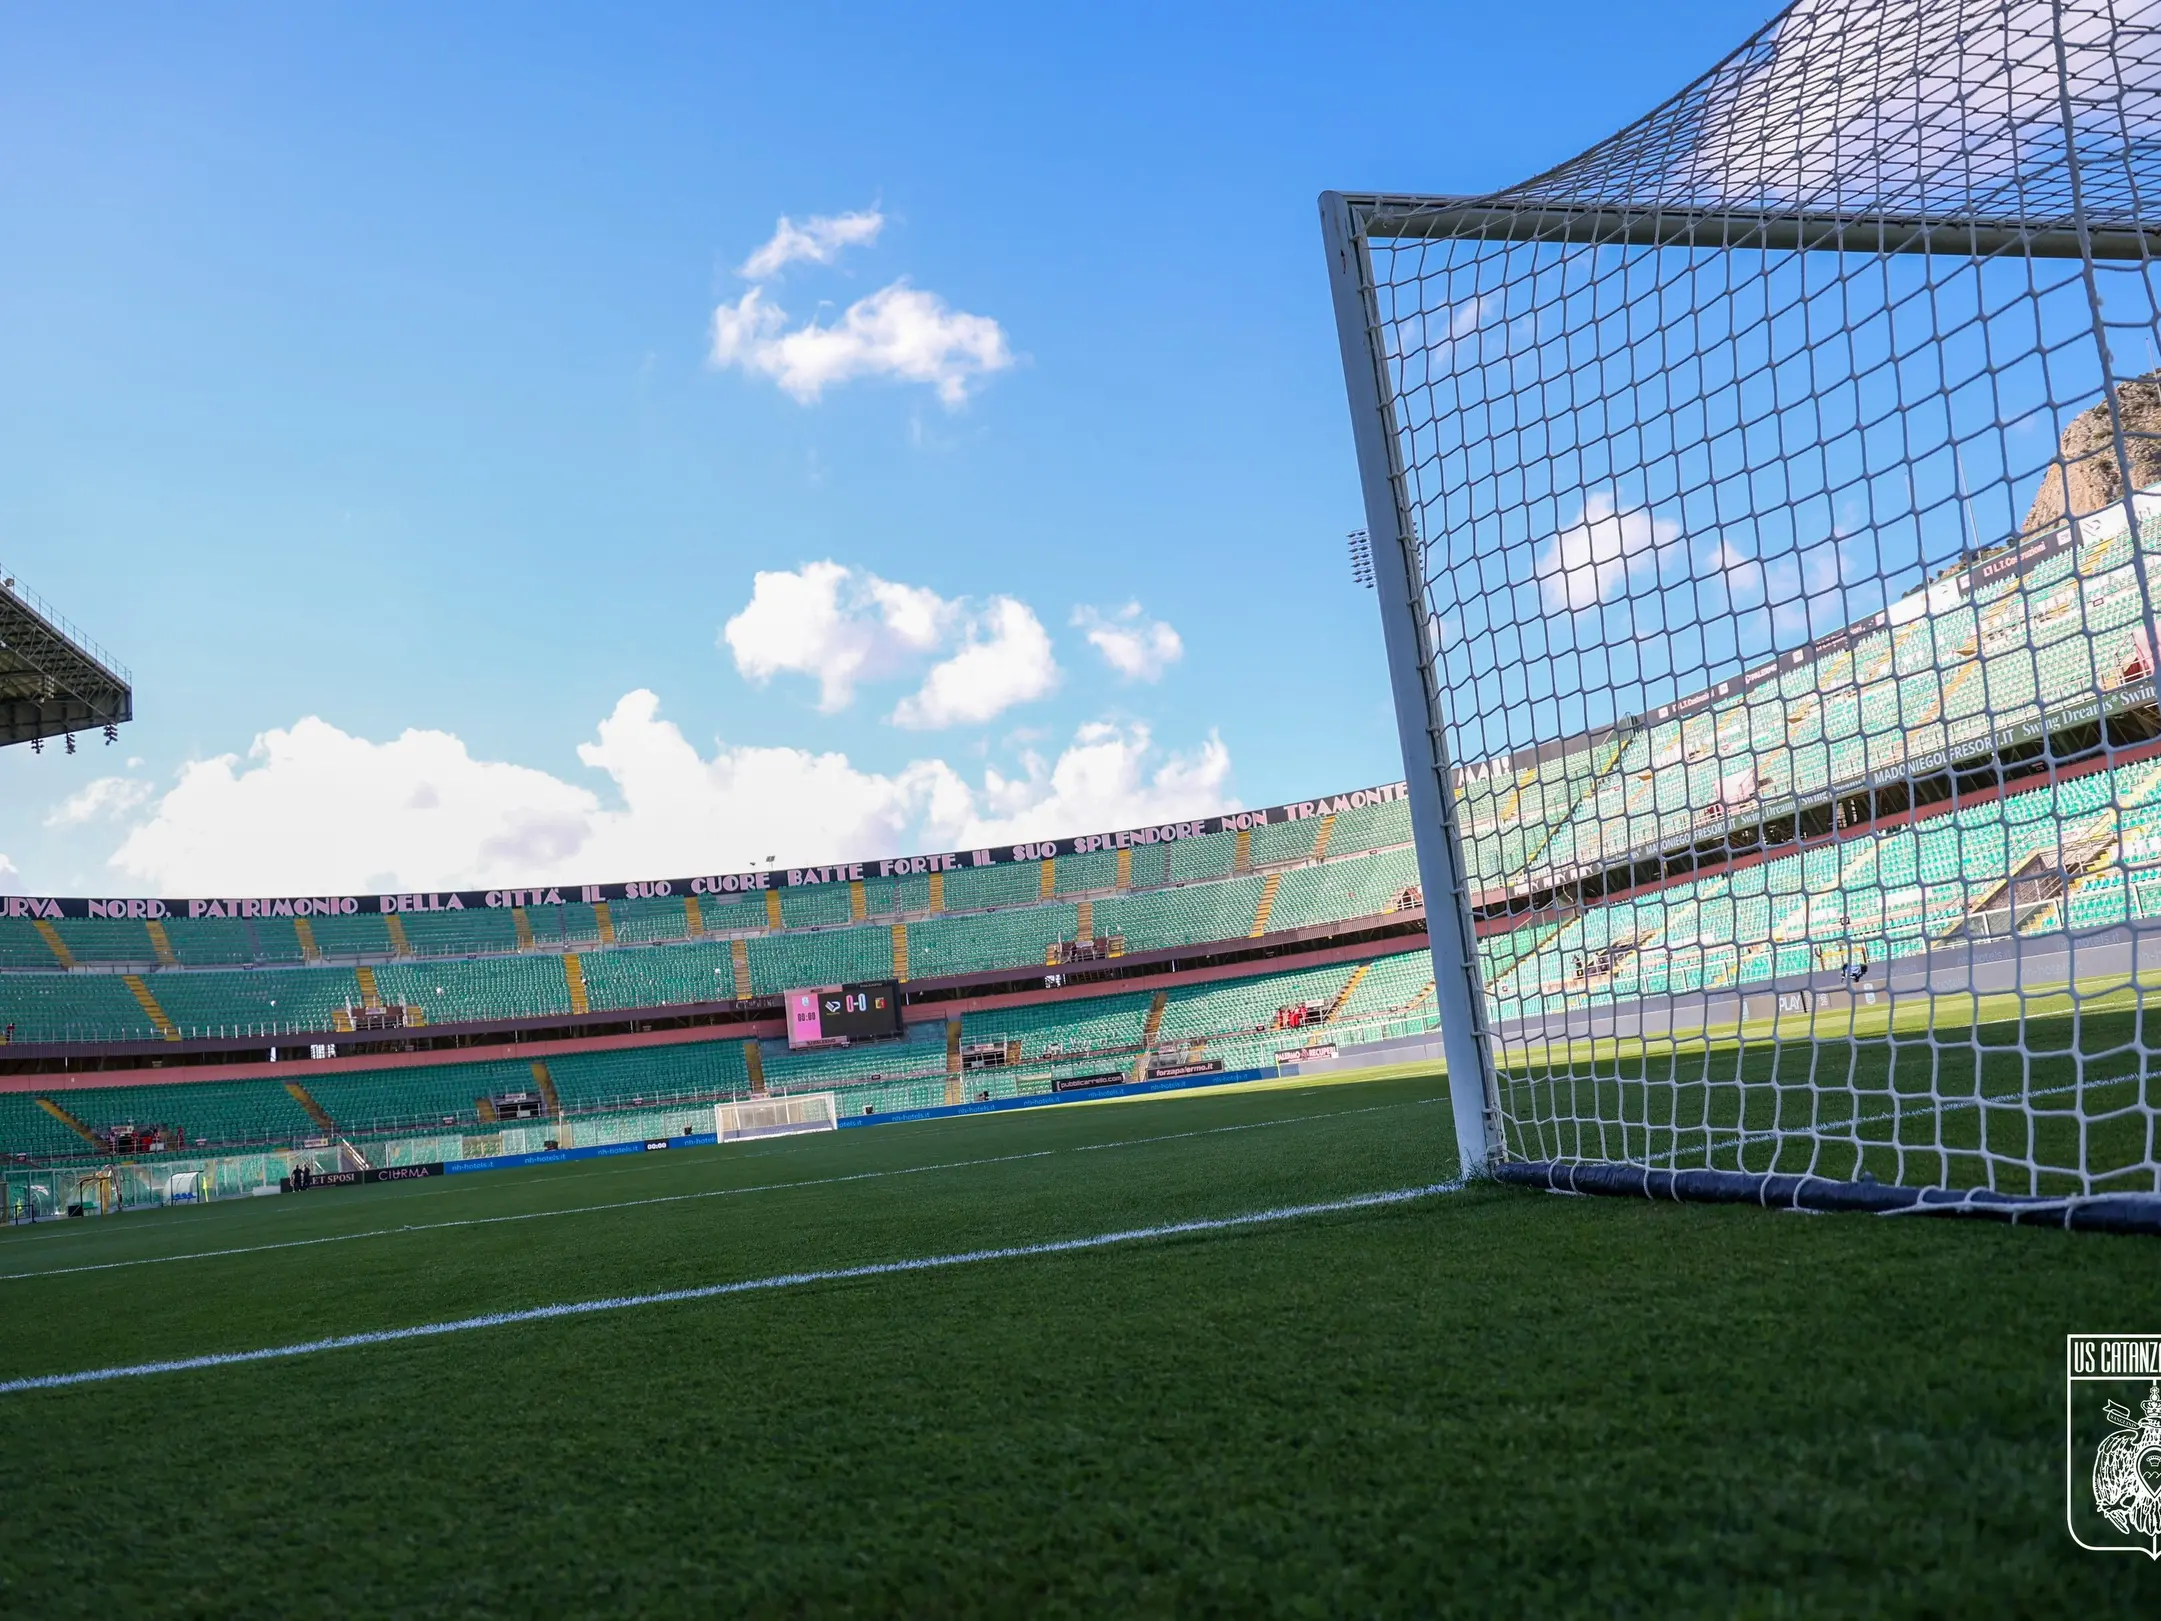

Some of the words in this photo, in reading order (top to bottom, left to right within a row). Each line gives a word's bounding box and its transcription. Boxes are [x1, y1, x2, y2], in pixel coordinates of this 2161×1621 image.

[188, 897, 358, 919] PATRIMONIO
[379, 893, 465, 913] DELLA
[581, 885, 606, 903] IL
[625, 880, 672, 900] SUO
[690, 872, 771, 894] CUORE
[787, 863, 864, 886] BATTE
[972, 850, 996, 866] IL
[1013, 841, 1057, 861] SUO
[1073, 820, 1206, 854] SPLENDORE
[1221, 810, 1268, 832] NON
[1156, 1063, 1213, 1077] forzapalermo.it
[327, 1173, 355, 1184] SPOSI
